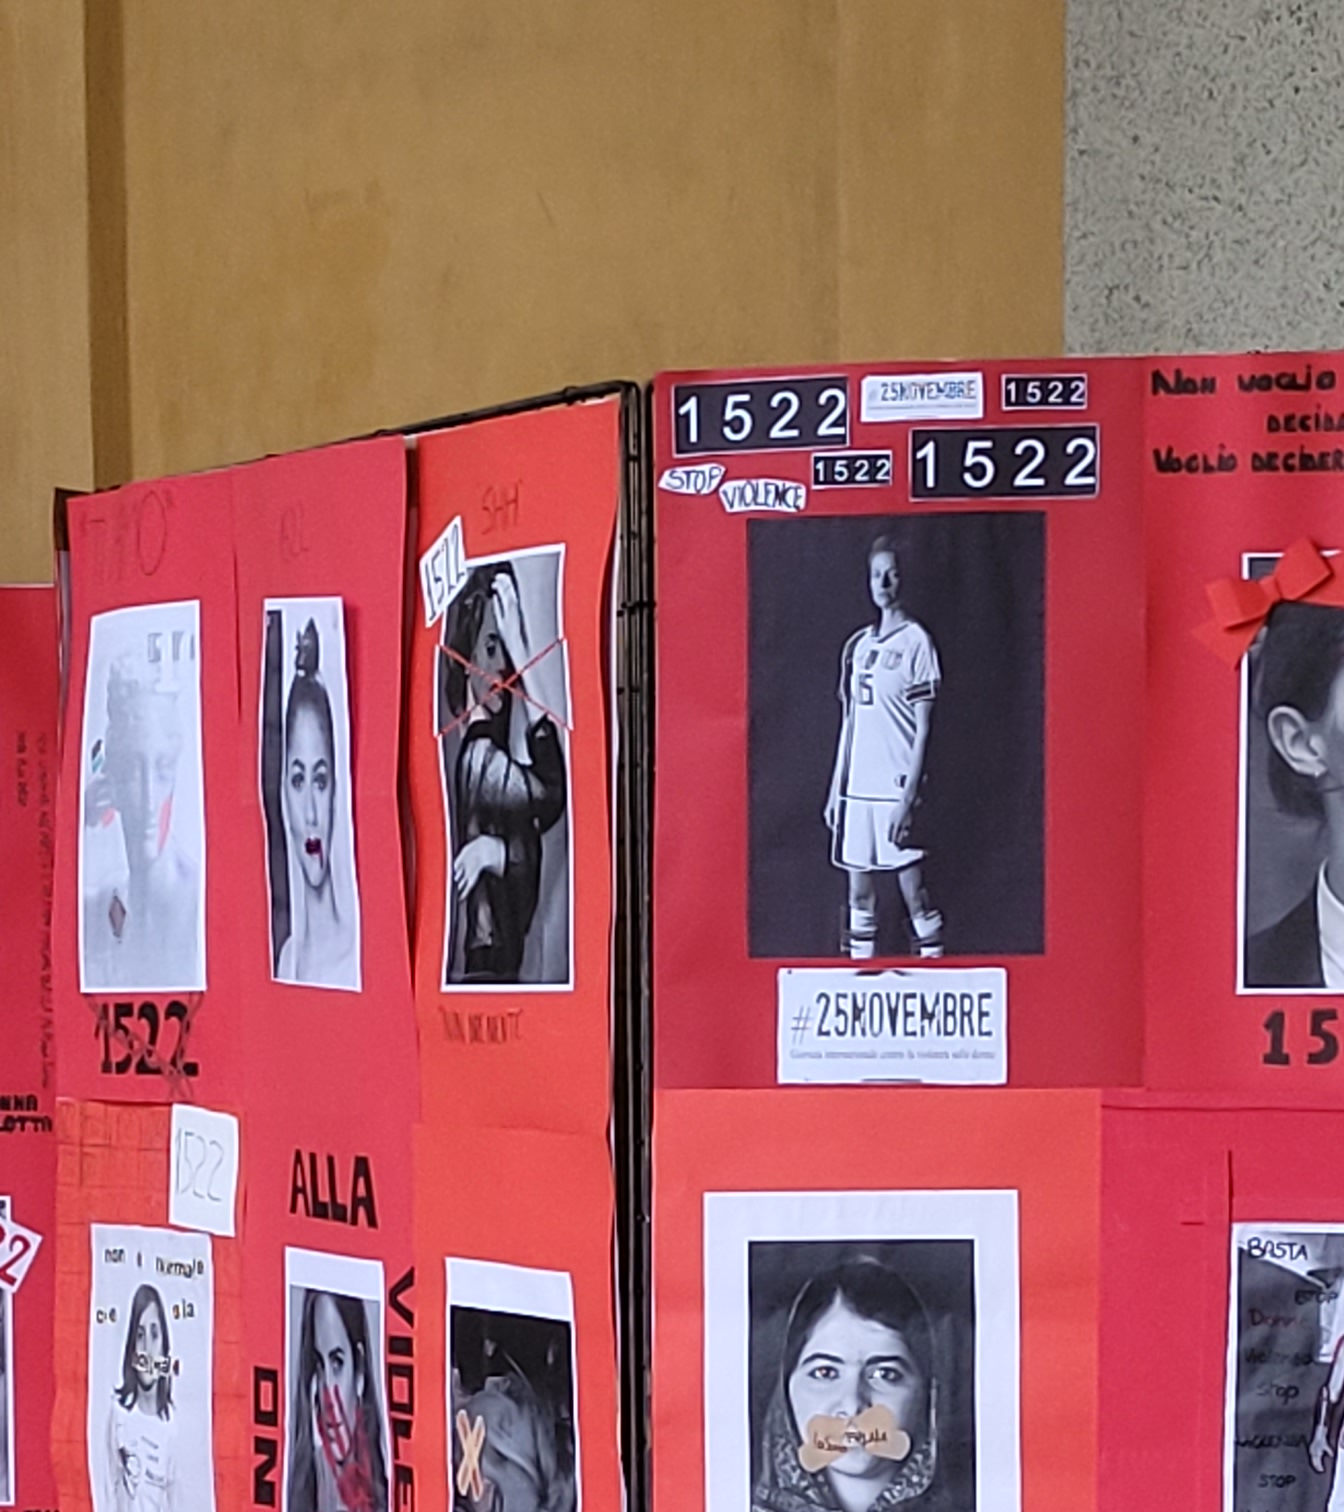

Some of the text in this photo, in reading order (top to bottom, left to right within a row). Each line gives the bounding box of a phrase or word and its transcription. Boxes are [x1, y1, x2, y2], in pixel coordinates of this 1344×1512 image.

[678, 387, 846, 443] 1522
[1006, 380, 1086, 403] 1522
[666, 467, 723, 494] STOP
[816, 459, 891, 482] 1522
[915, 437, 1097, 489] 1522
[721, 482, 805, 511] VIOLENCE
[94, 1002, 200, 1078] 1522
[790, 991, 994, 1046] #25NOVEMBRE
[173, 1127, 225, 1203] 1522
[289, 1147, 378, 1230] ALLA
[1246, 1236, 1309, 1261] BASTA
[253, 1365, 280, 1509] NO
